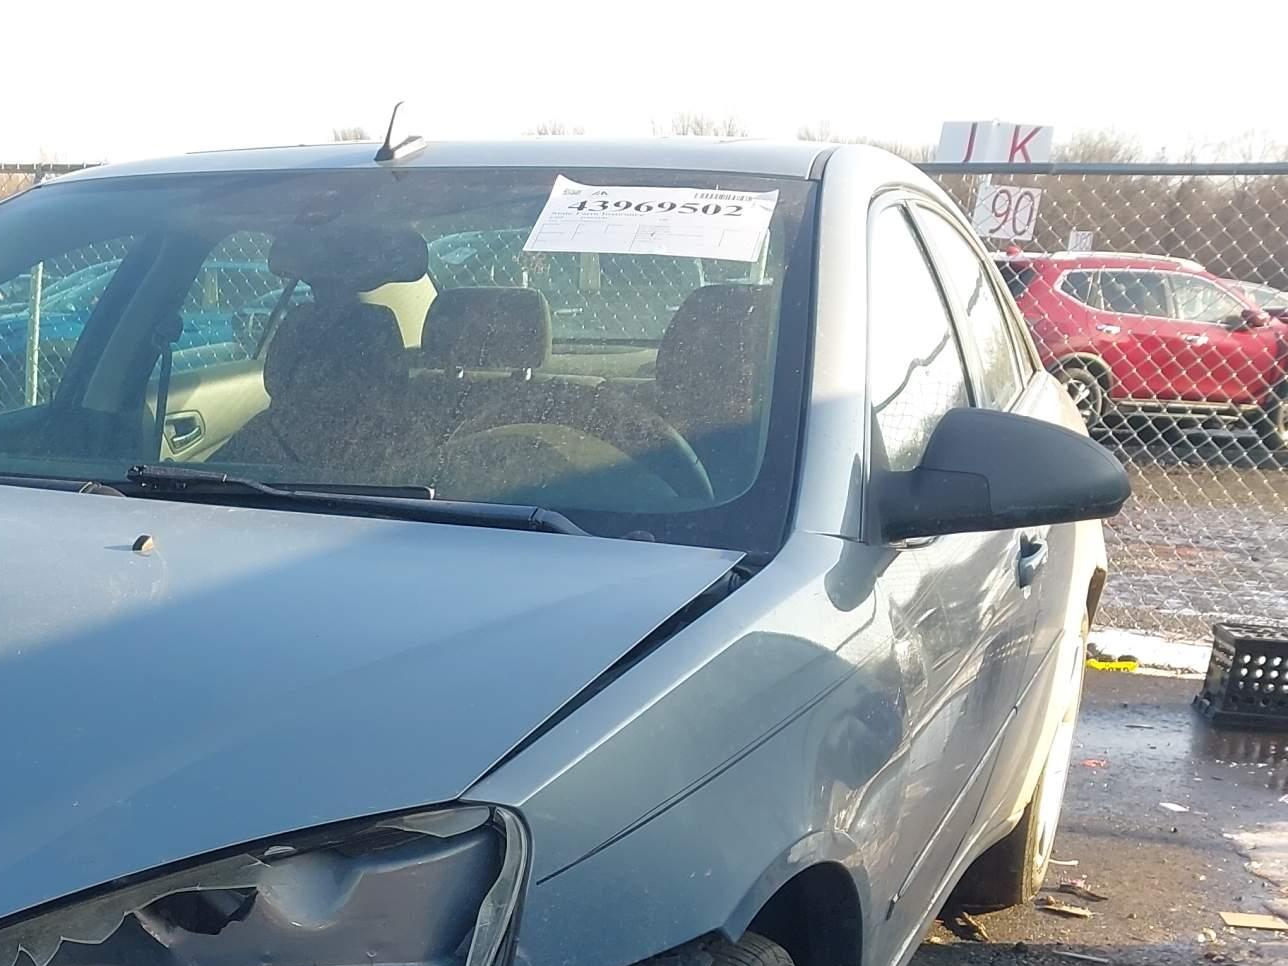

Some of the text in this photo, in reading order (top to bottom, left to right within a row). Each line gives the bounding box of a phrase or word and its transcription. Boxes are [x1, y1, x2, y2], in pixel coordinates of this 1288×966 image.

[1008, 124, 1044, 164] K
[567, 199, 744, 217] 43969502
[988, 188, 1035, 236] 90
